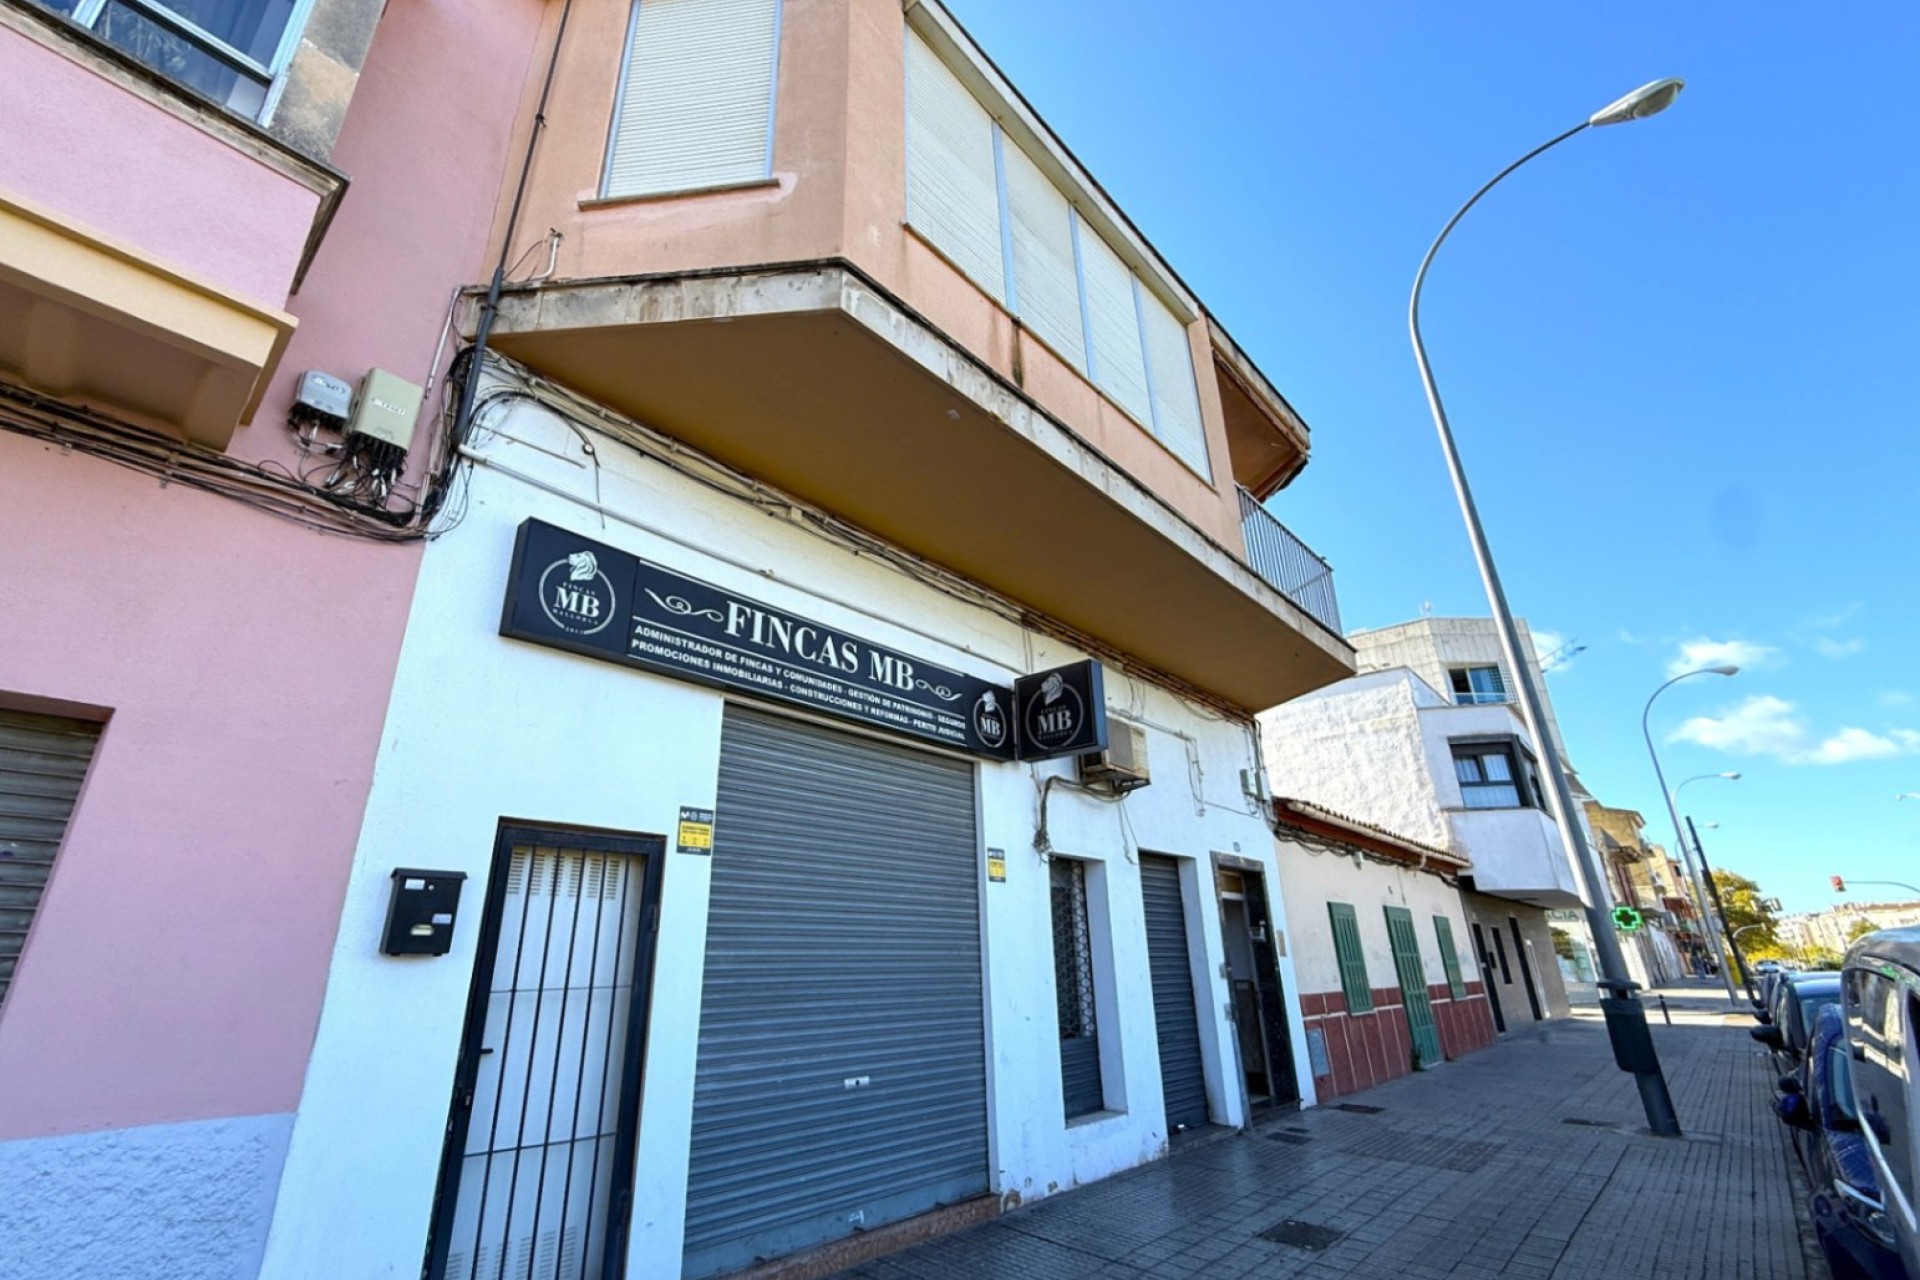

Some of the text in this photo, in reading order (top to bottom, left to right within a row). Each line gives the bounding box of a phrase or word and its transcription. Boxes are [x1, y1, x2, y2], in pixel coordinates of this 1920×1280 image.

[553, 586, 600, 618] MB
[634, 625, 722, 658] ADMINISTRADOR
[725, 651, 738, 663] DE
[740, 656, 773, 674] FINCAS
[775, 667, 781, 675] Y
[783, 669, 843, 693] COMUNIDADES
[724, 600, 914, 691] FINCAS MB
[632, 638, 710, 669] PROMOCIONES
[712, 661, 783, 689] INMOBILIARIAS
[789, 684, 862, 711] CONSTRUCCIONES
[981, 717, 1001, 736] MB
[1037, 709, 1072, 734] MB
